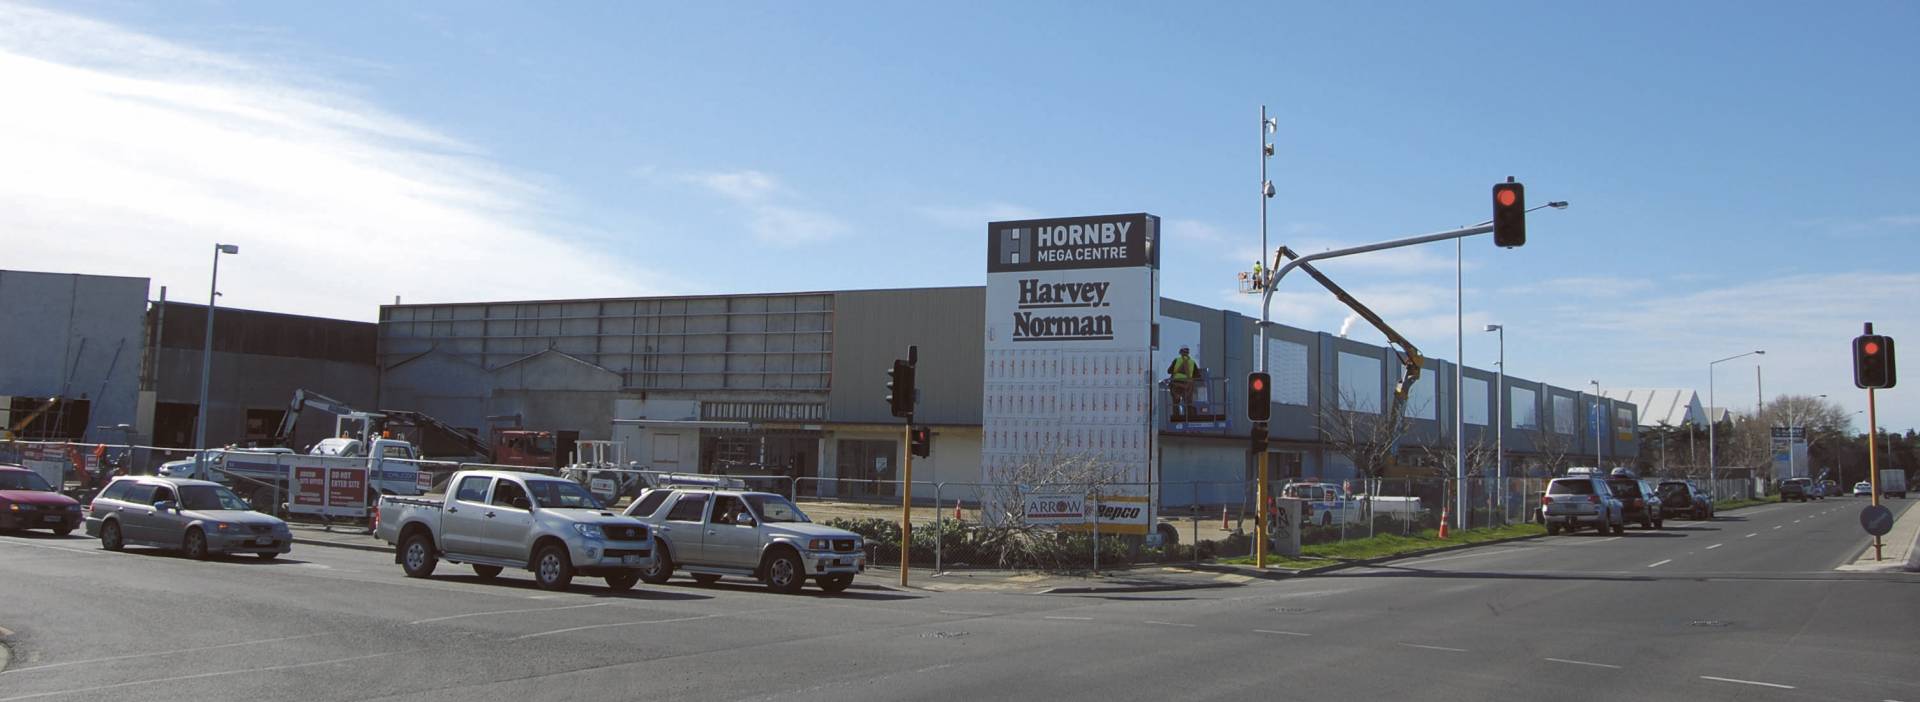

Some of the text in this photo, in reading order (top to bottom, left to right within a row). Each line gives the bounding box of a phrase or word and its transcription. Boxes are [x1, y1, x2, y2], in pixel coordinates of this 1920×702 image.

[1037, 222, 1132, 247] HORNBY
[1038, 247, 1127, 262] MEGA CENTRE
[1018, 279, 1110, 308] Harvey
[1013, 312, 1112, 337] Norman
[1029, 500, 1081, 512] ARROW
